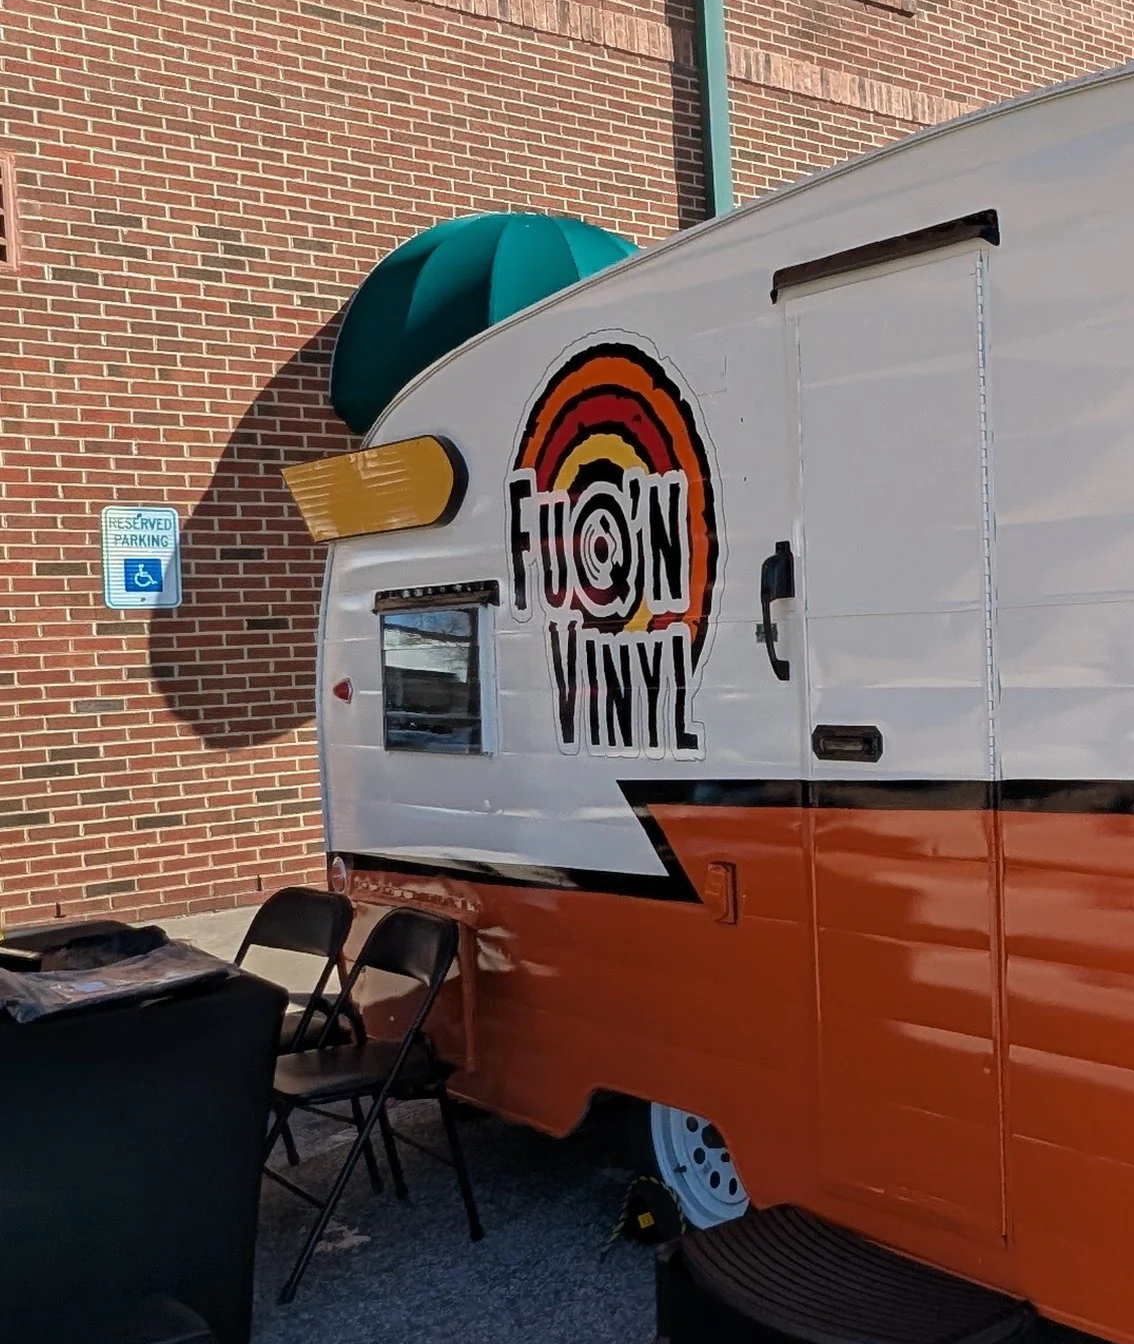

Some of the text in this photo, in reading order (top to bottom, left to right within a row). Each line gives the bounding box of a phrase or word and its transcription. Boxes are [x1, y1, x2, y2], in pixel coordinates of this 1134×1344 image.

[109, 516, 172, 531] RESERVED
[114, 534, 169, 548] PARKING
[549, 621, 698, 750] VINYL
